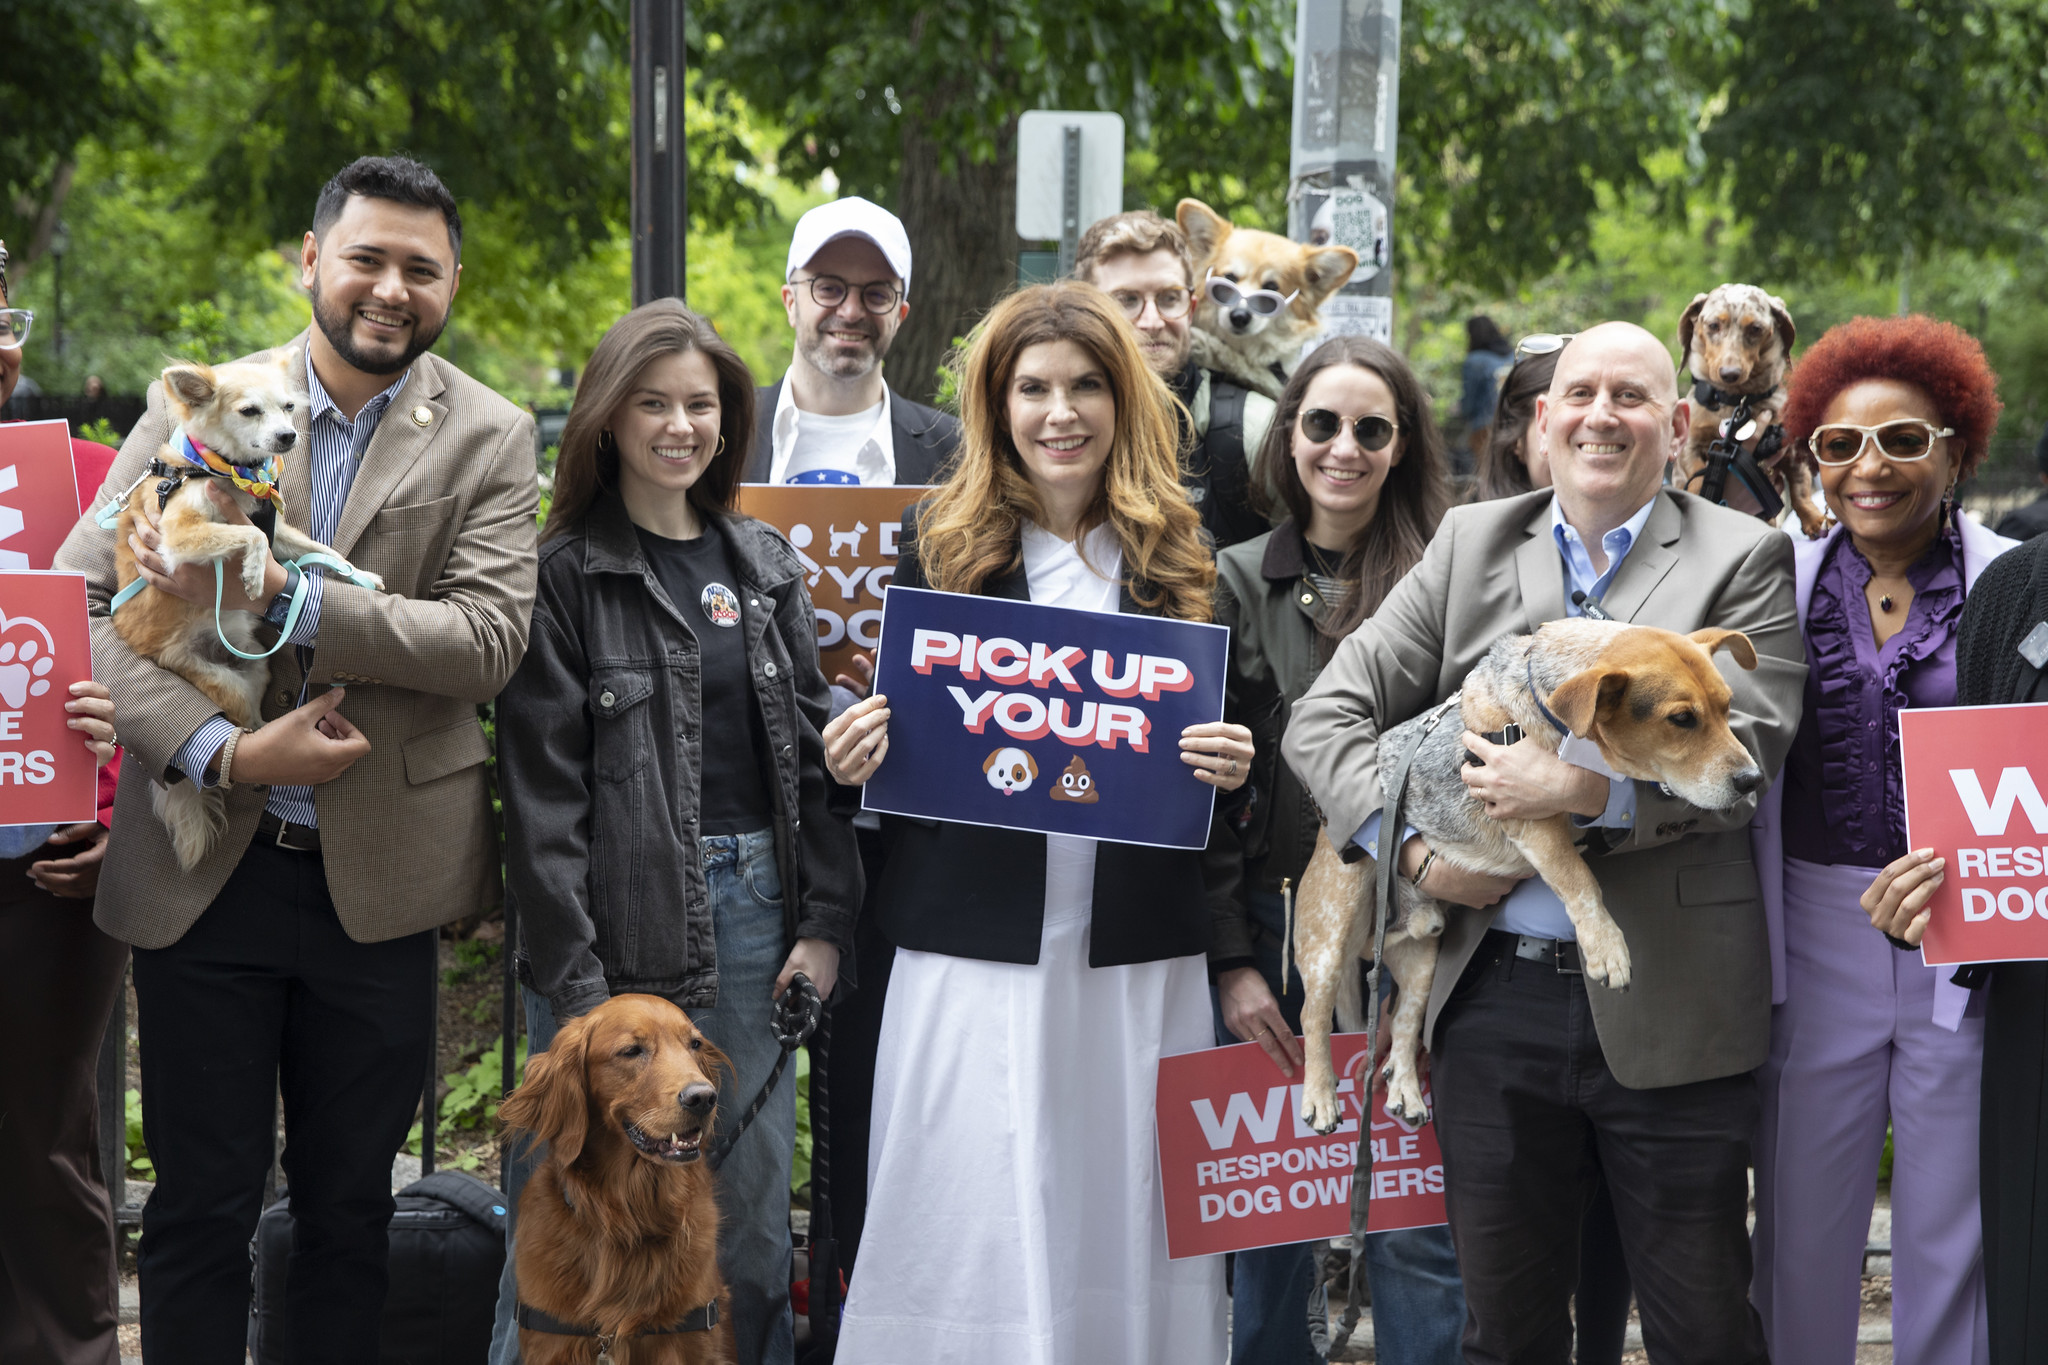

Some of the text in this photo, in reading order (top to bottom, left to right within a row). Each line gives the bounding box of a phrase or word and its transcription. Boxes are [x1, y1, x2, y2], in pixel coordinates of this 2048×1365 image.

[911, 628, 1194, 701] PICK UP
[946, 685, 1151, 753] YOUR
[1957, 846, 2048, 878] RES
[1198, 1185, 1283, 1223] DOG
